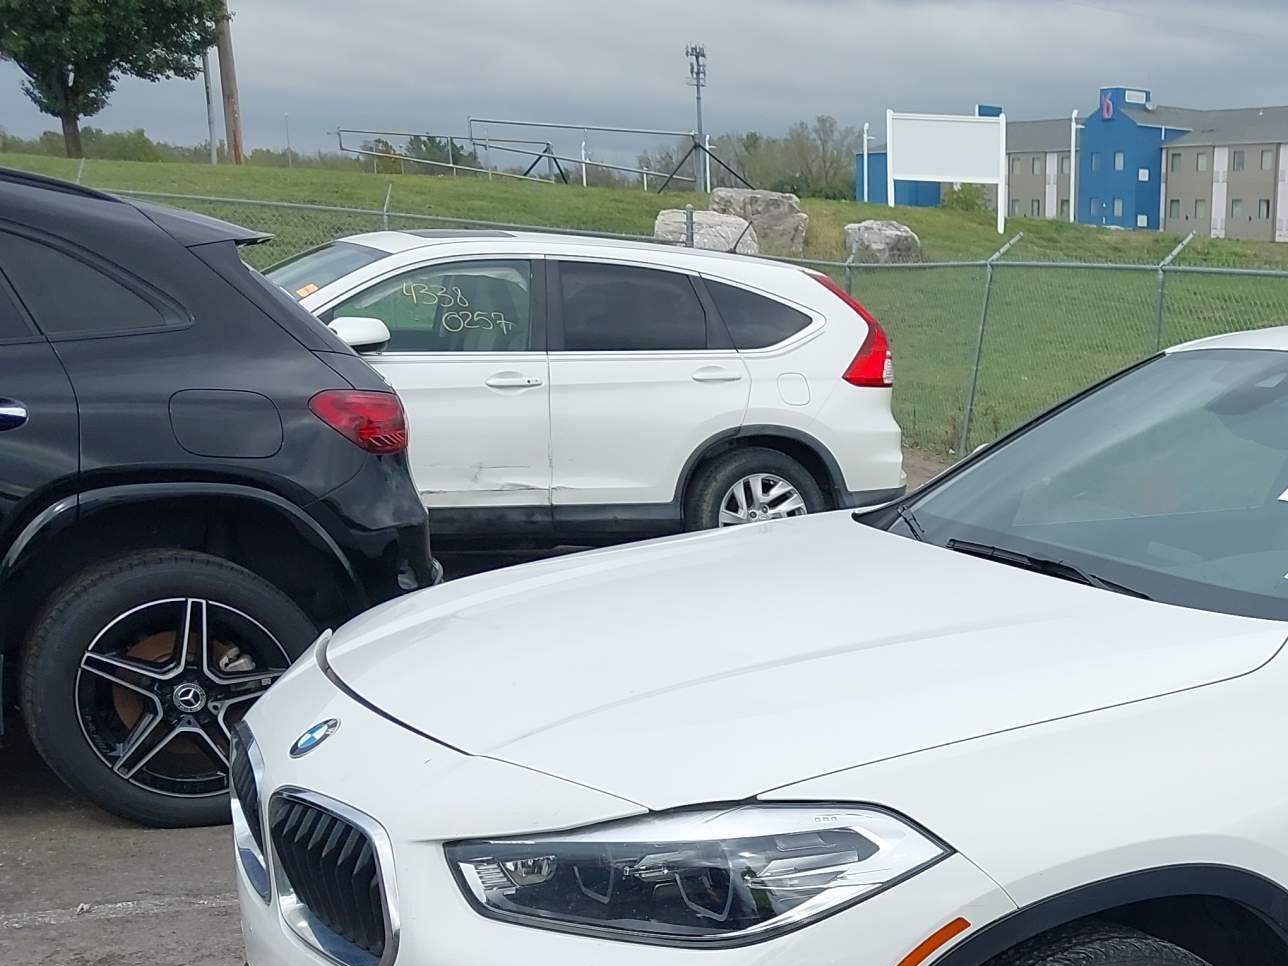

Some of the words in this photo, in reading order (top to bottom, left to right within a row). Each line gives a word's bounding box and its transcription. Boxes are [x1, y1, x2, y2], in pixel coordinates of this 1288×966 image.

[1103, 92, 1113, 119] 6
[402, 281, 469, 308] 4338
[442, 311, 513, 335] 0257
